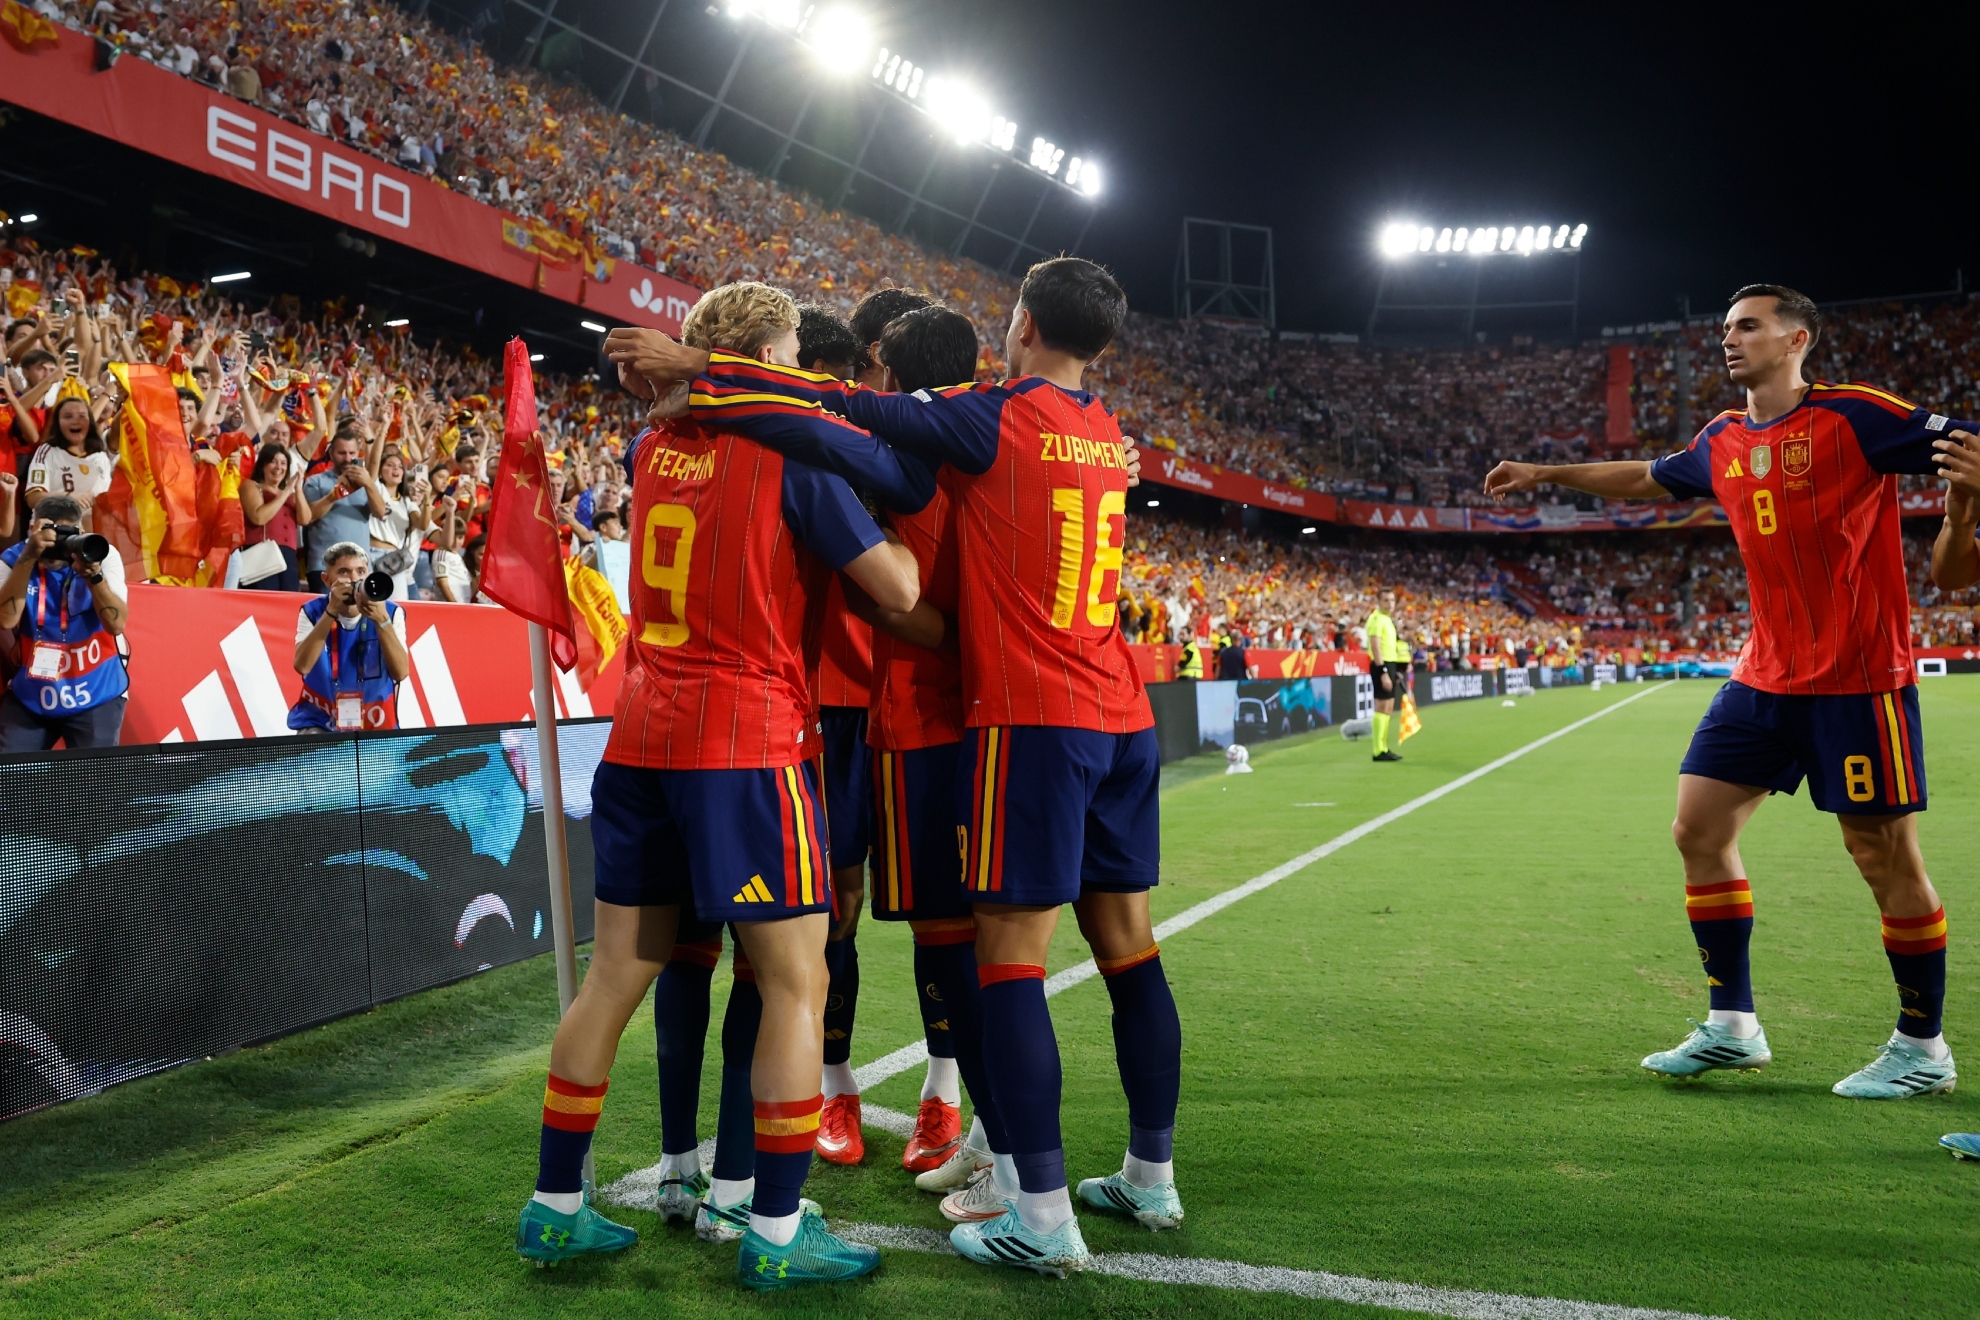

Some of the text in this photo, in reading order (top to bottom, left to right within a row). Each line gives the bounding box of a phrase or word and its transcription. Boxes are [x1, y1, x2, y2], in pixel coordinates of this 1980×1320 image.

[207, 105, 411, 228] EBRO
[62, 473, 75, 493] 6
[1753, 490, 1777, 535] 8
[638, 503, 696, 647] 9
[40, 681, 92, 711] 065
[1844, 755, 1875, 802] 8
